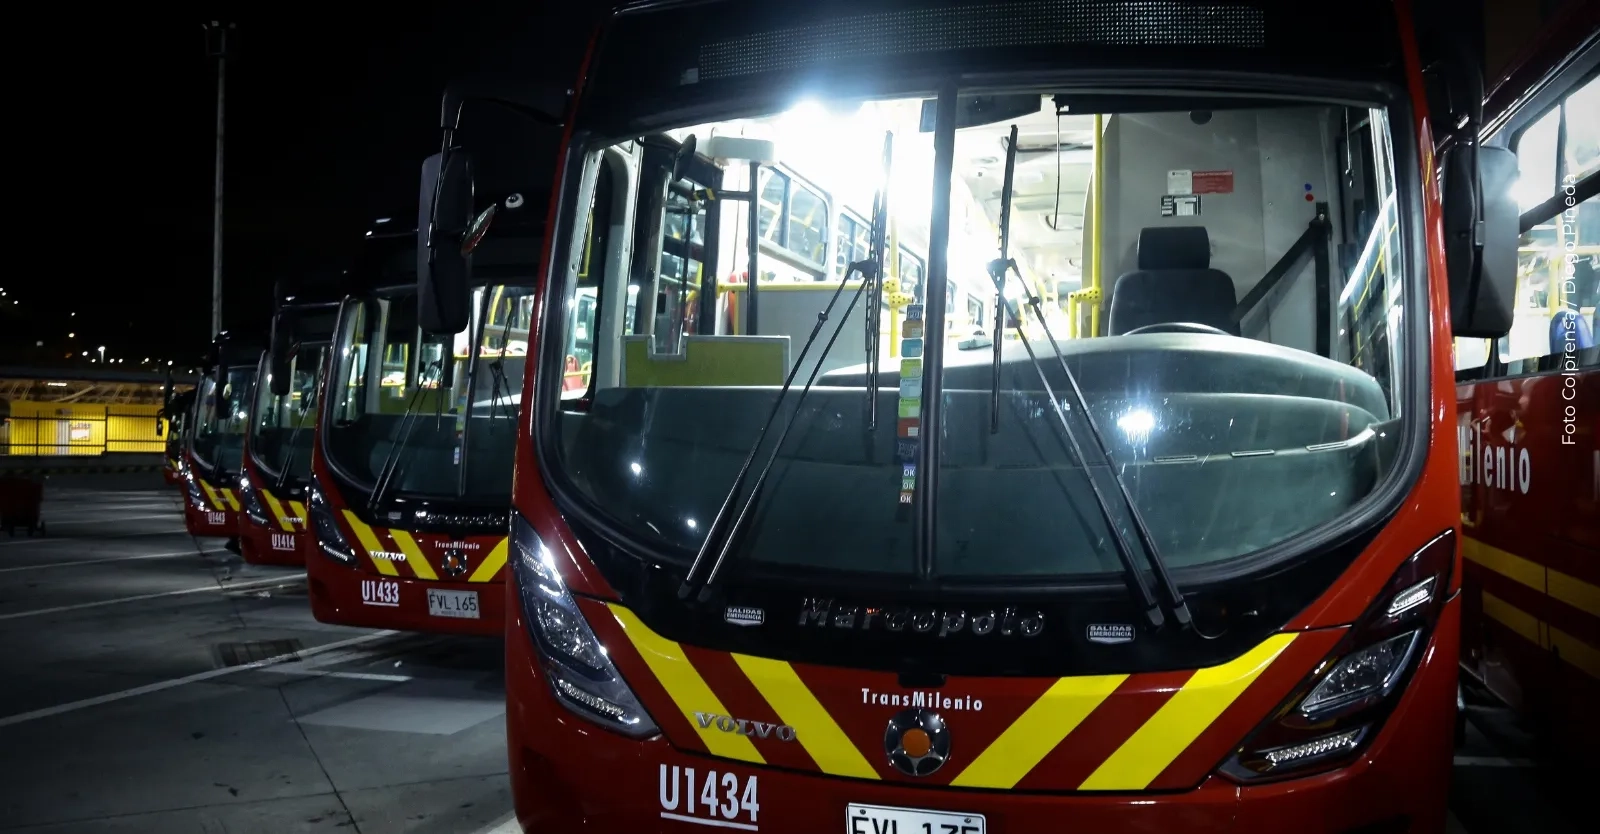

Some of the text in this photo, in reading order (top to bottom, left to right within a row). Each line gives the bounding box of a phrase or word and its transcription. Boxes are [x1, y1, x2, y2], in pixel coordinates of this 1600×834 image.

[272, 533, 296, 549] U1414
[434, 540, 480, 551] TransMilenio
[369, 550, 406, 562] VOLVO
[361, 579, 399, 603] U1433
[429, 594, 477, 611] FVL 165
[727, 607, 762, 615] SALIDAS
[798, 597, 1045, 638] Marcopolo
[861, 687, 984, 712] TransMilenio
[692, 711, 797, 742] VOLVO
[659, 763, 759, 822] U1434
